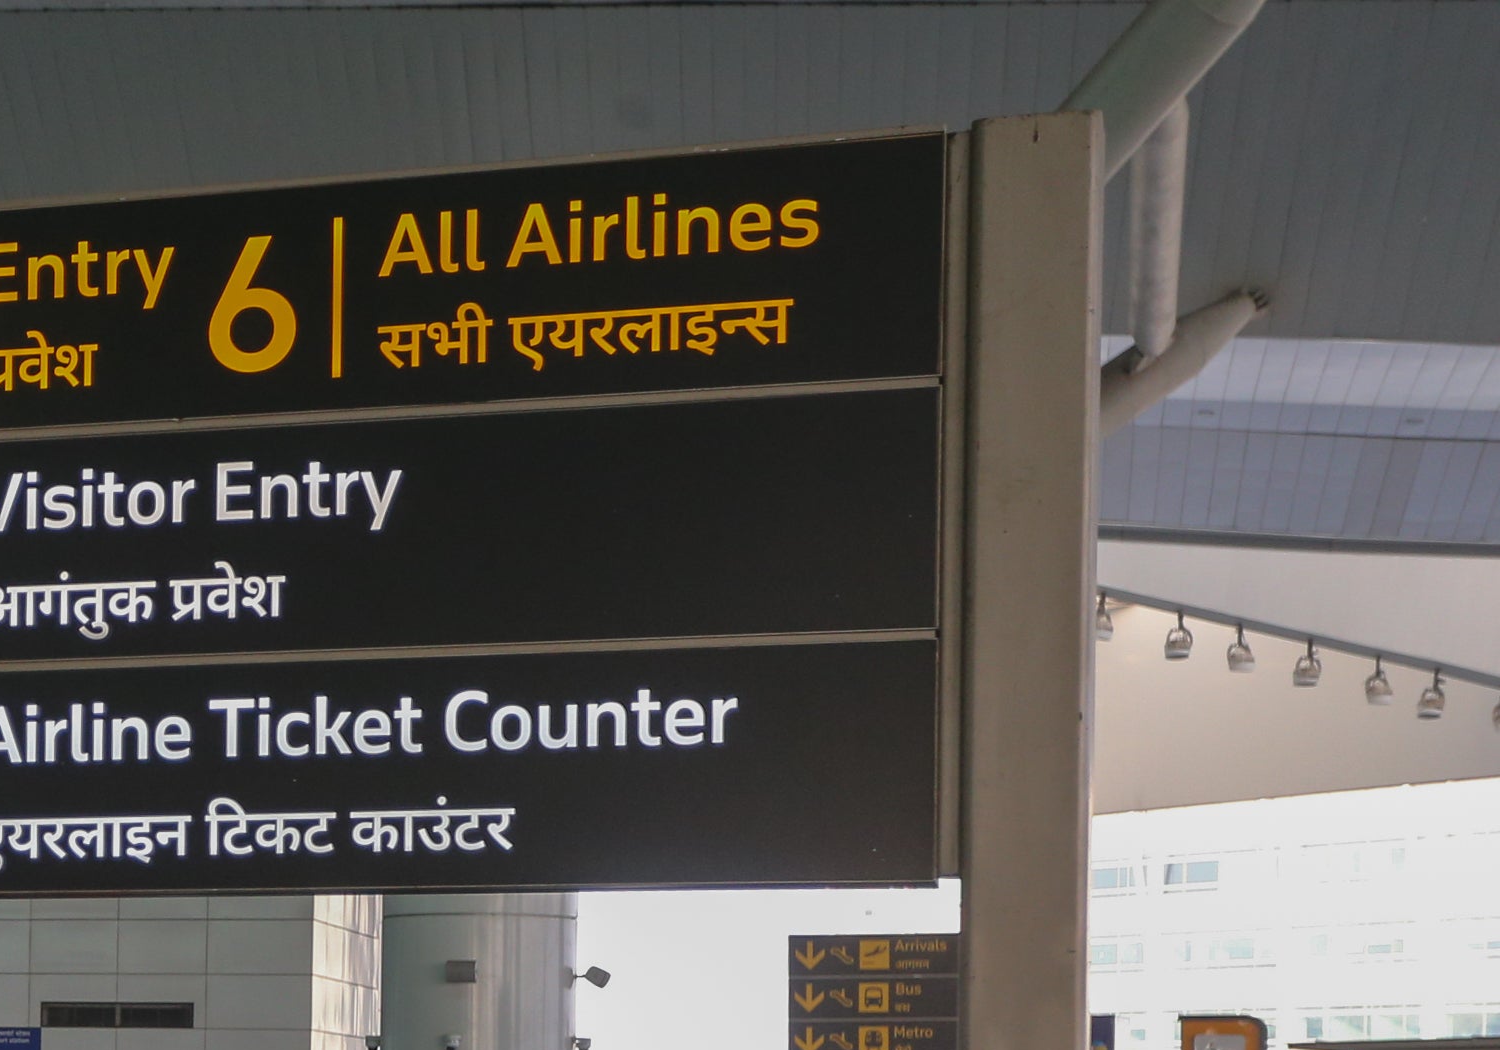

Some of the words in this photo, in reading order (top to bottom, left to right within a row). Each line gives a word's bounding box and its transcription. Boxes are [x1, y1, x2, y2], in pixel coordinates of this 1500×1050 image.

[379, 209, 485, 277] All
[506, 193, 820, 267] Airlines
[209, 236, 297, 373] 6
[378, 302, 493, 369] सभी
[508, 299, 794, 371] एयरलाइन्स
[216, 461, 403, 531] Entry
[169, 561, 286, 621] प्रवेश
[209, 696, 422, 758] Ticket
[445, 689, 738, 752] Counter
[204, 798, 336, 856] टिकट
[350, 796, 516, 853] काउंटर
[894, 939, 948, 952] Arrivals
[895, 982, 922, 996] Bus
[894, 1025, 933, 1038] Metro
